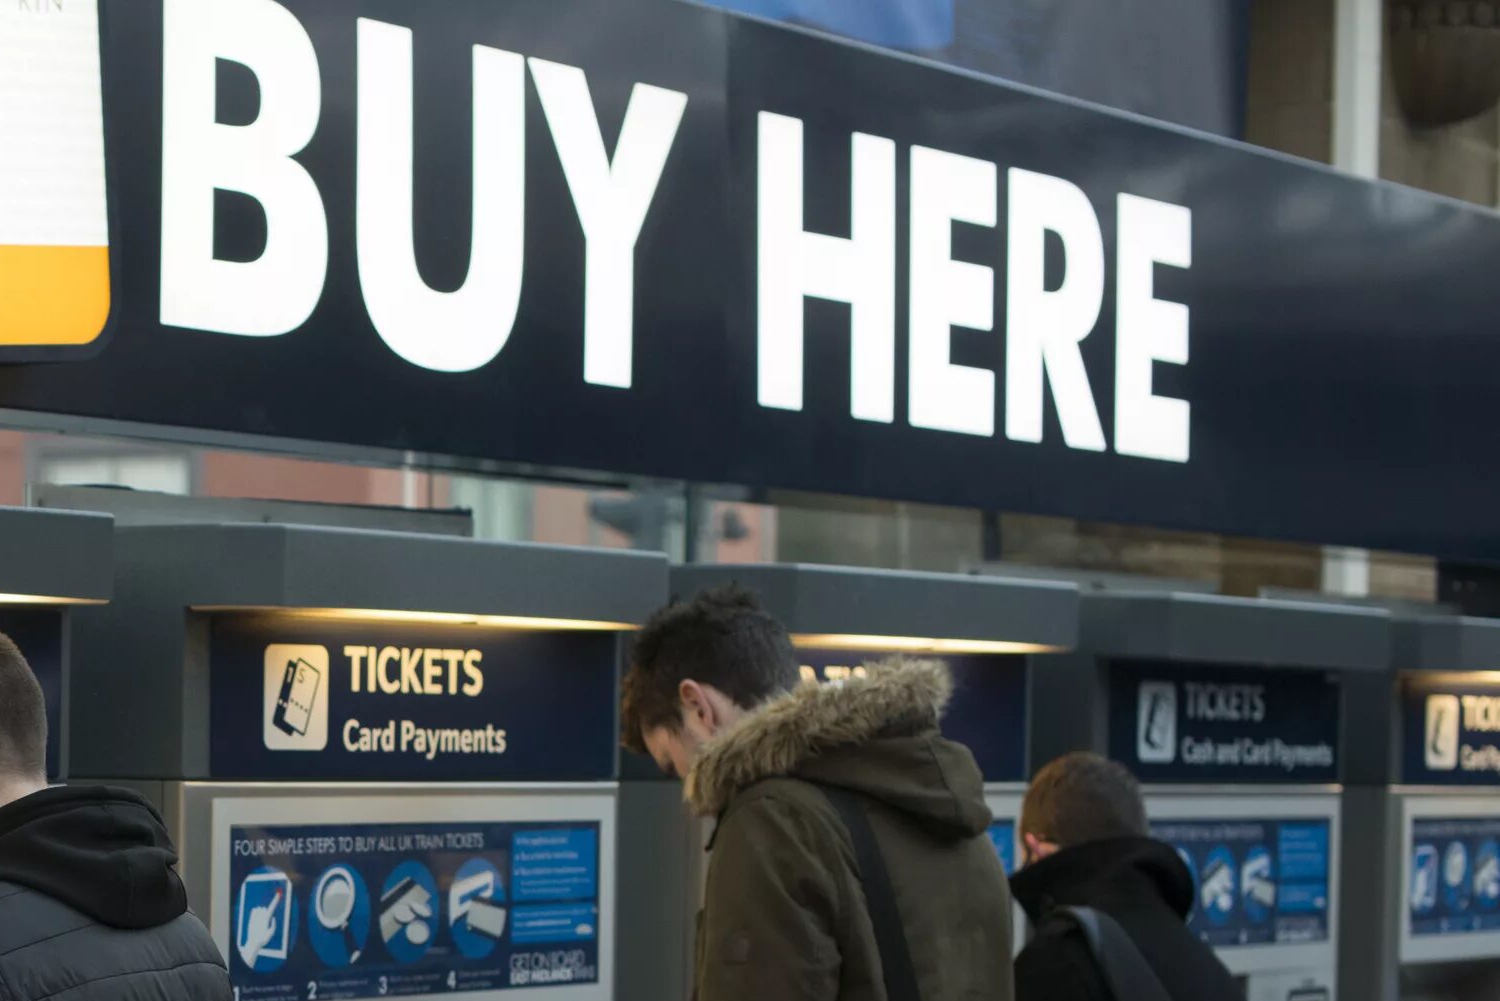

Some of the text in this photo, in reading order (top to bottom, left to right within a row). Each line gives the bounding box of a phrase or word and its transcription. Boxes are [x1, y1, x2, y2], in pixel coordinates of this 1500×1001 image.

[159, 0, 1192, 463] BUY HERE
[343, 645, 483, 696] TICKETS
[1184, 683, 1265, 722] TICKETS
[343, 719, 507, 760] Card Payments
[1181, 737, 1333, 771] Cash and Card Payments
[234, 839, 264, 856] FOUR
[268, 838, 303, 855] SIMPLE
[307, 837, 336, 854] STEPS
[338, 837, 353, 853] TO
[355, 836, 377, 852] BUY
[377, 835, 396, 851] ALL
[414, 834, 444, 850] TRAIN
[446, 832, 484, 849] TICKETS
[307, 981, 317, 999] 2
[379, 976, 388, 994] 3
[447, 971, 456, 989] 4
